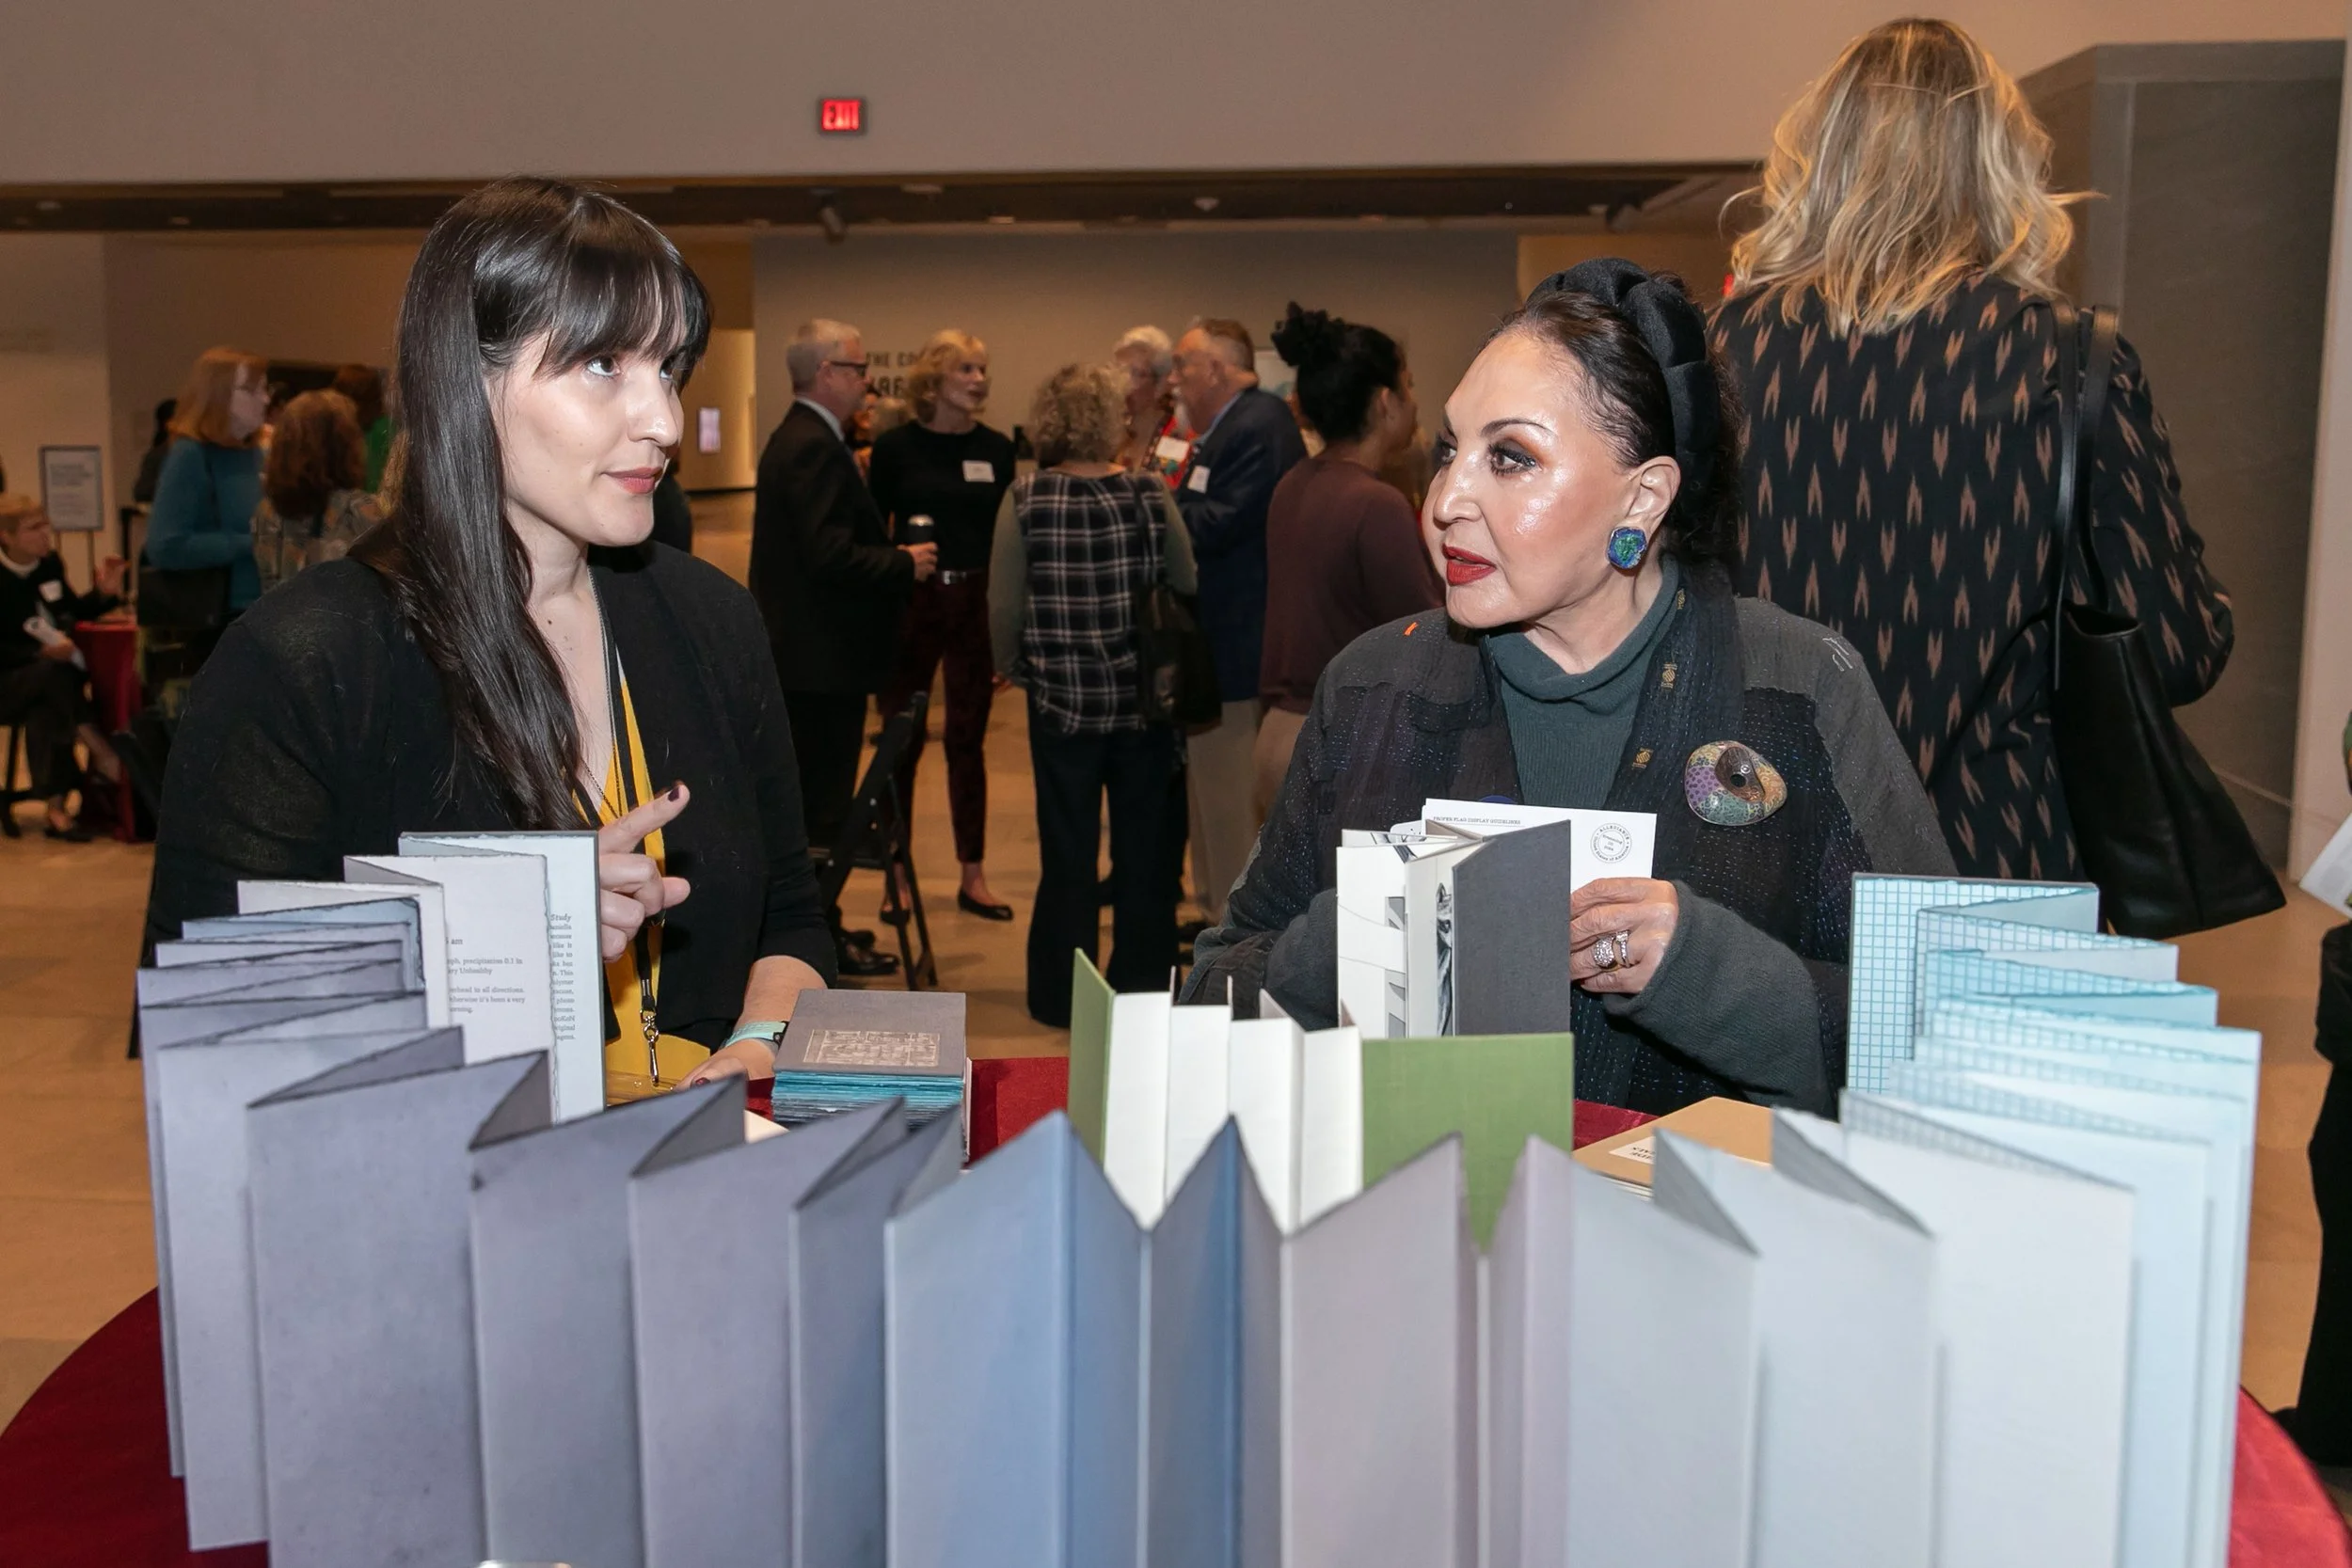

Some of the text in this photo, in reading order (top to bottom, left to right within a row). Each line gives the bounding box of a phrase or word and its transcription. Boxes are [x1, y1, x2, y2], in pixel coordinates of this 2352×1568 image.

[822, 100, 859, 130] EXIT
[1599, 825, 1629, 840] ALLEGIANCE
[550, 913, 572, 922] Study
[463, 958, 503, 966] precipitation
[460, 967, 493, 975] Unhealthy
